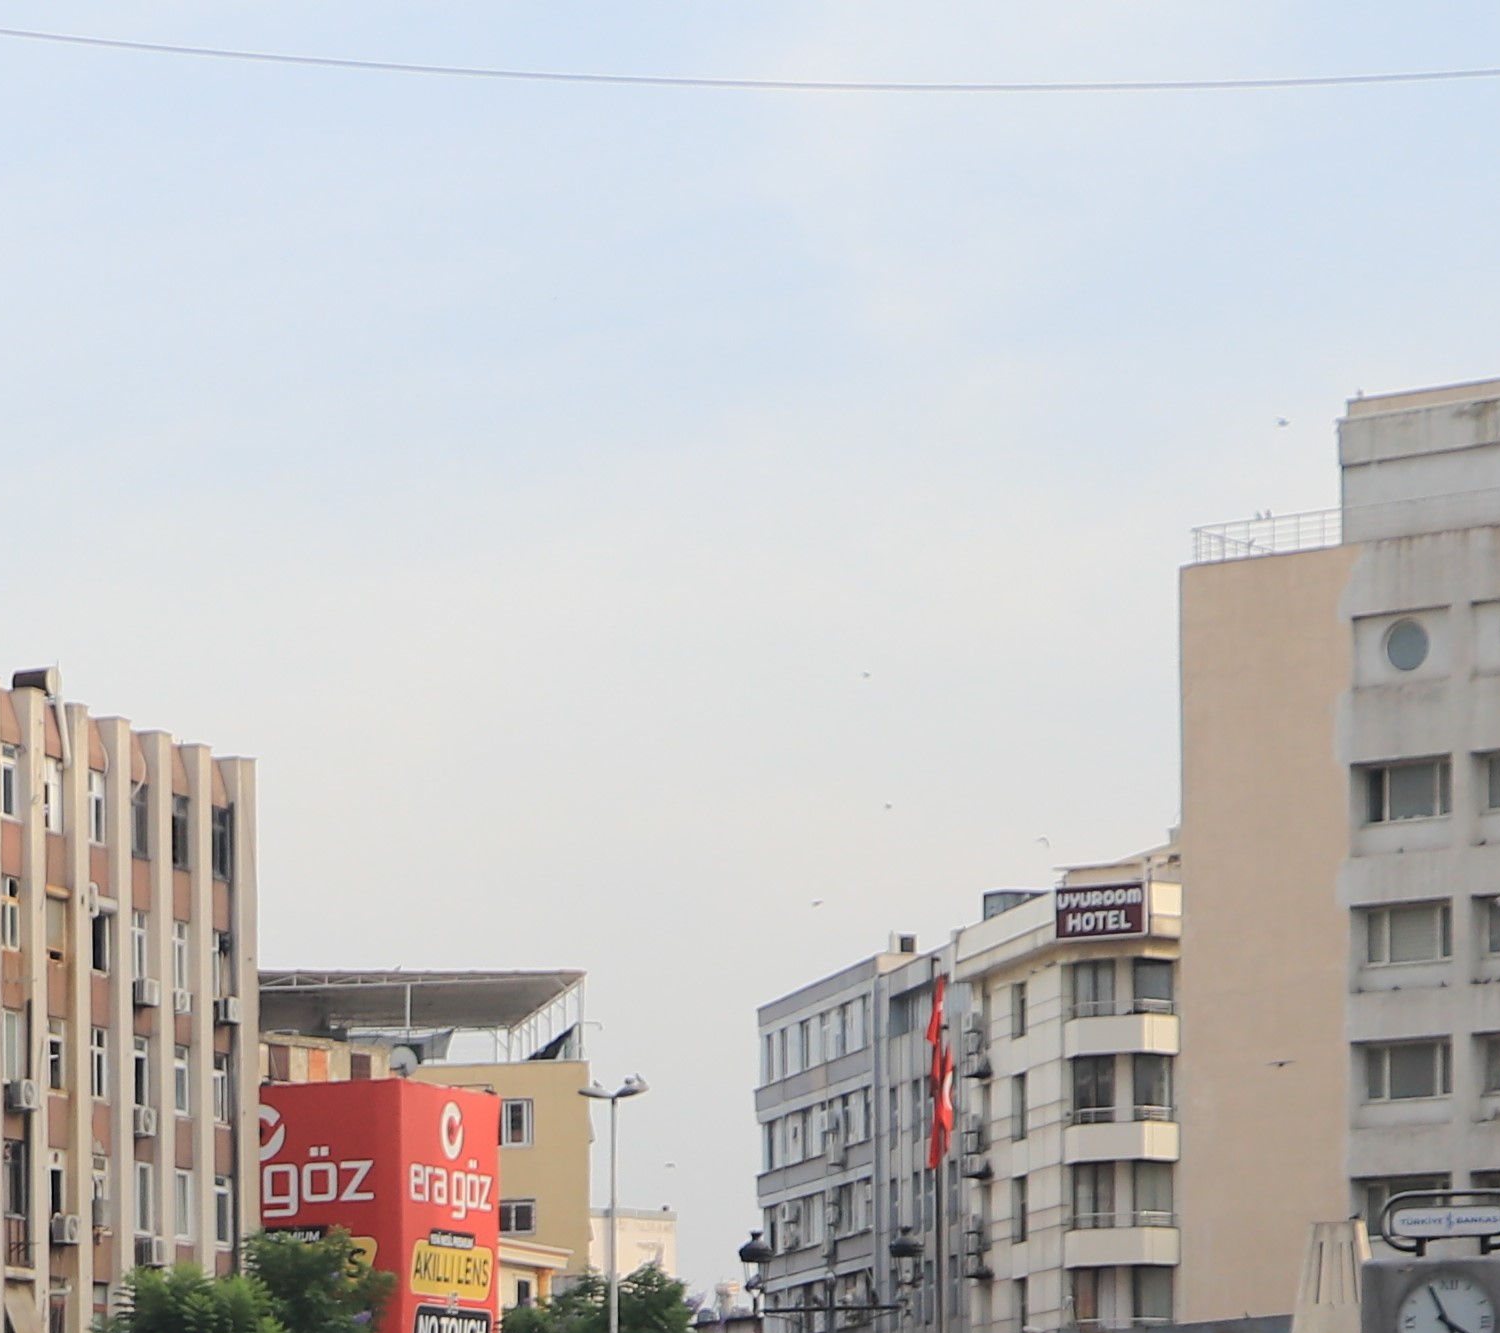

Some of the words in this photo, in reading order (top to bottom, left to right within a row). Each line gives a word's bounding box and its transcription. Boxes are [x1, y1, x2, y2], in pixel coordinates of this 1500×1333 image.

[1067, 910, 1132, 932] HOTEL
[263, 1146, 375, 1218] göz
[410, 1163, 448, 1205] era
[452, 1159, 493, 1220] göz
[414, 1251, 453, 1283] AKILLI
[457, 1257, 489, 1287] LENS
